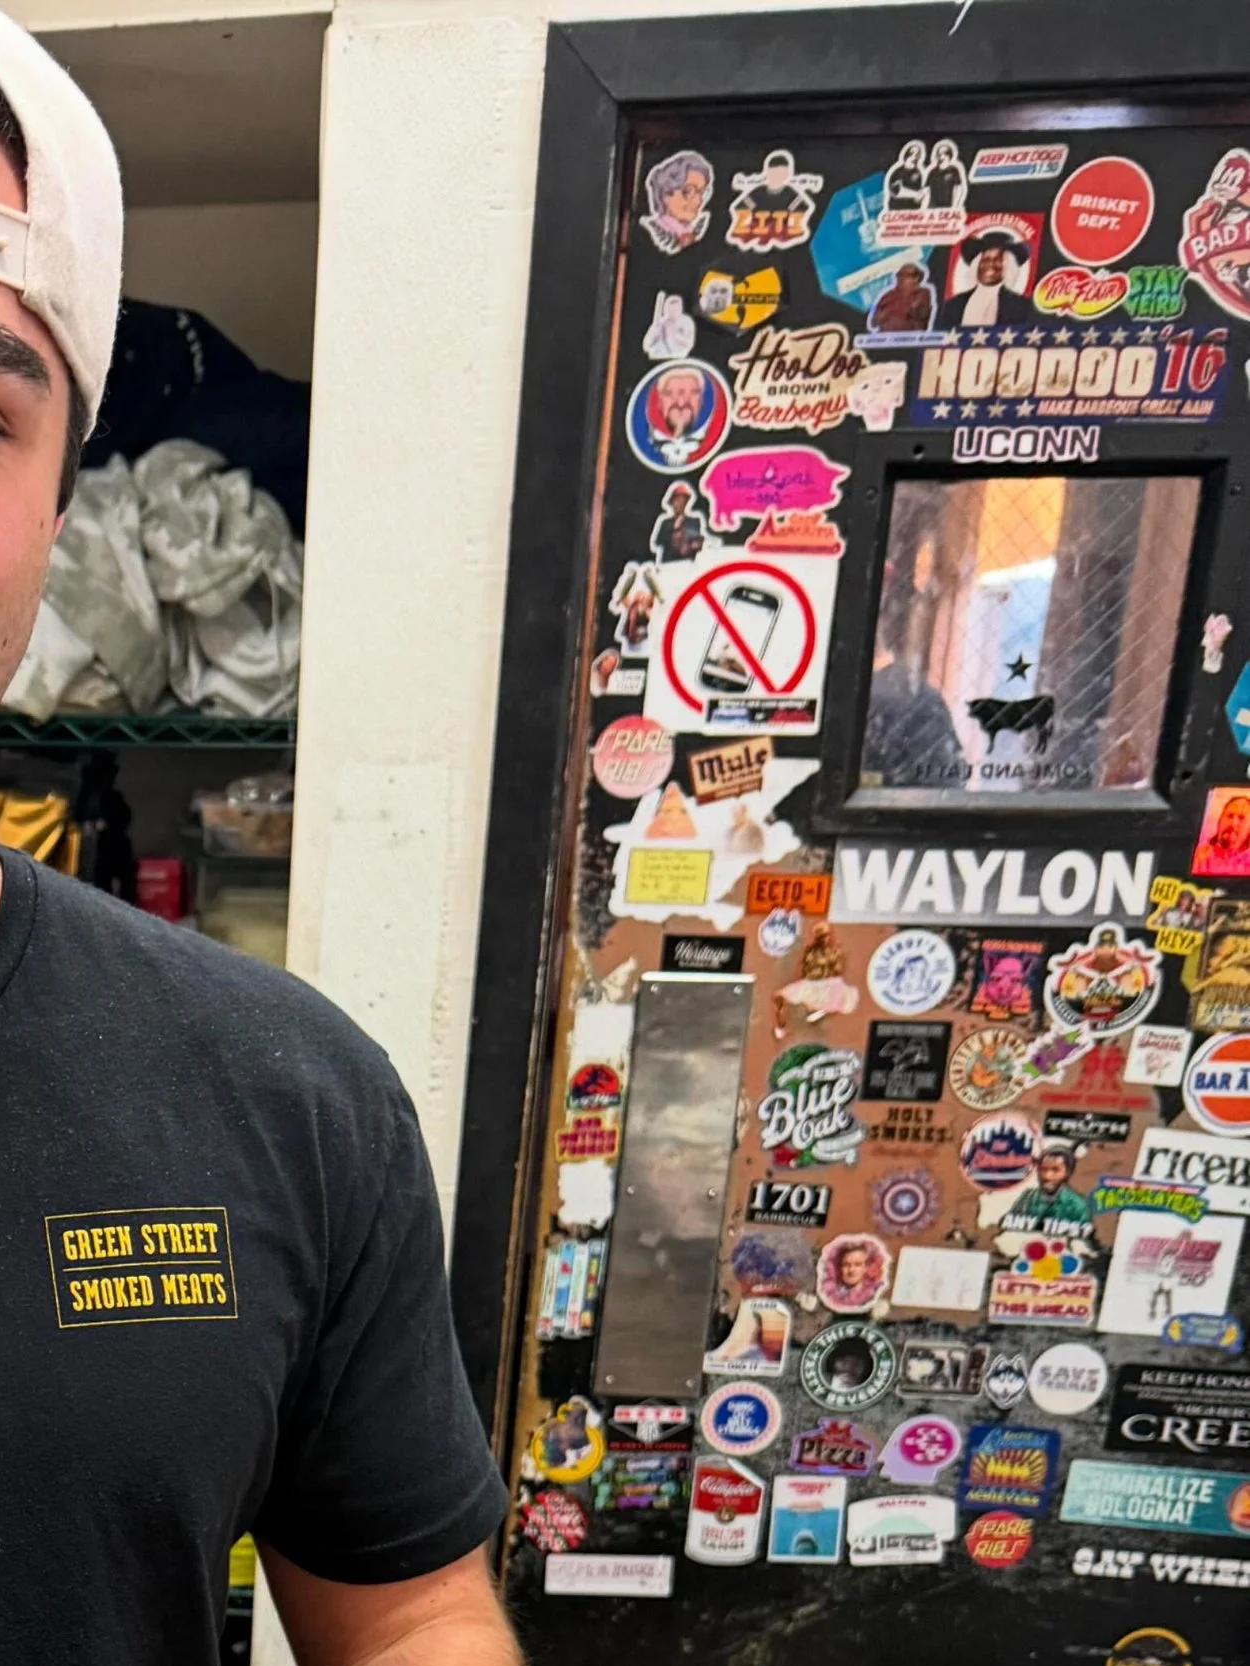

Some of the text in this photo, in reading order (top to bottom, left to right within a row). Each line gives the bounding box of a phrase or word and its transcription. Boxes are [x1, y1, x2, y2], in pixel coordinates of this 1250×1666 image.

[1069, 193, 1140, 214] BRISKET
[1077, 213, 1120, 230] DEPT.
[1191, 226, 1241, 259] BAD
[1130, 266, 1188, 292] STAY
[918, 347, 1158, 399] HOODOO
[767, 381, 831, 396] BROWN
[953, 426, 1101, 463] UCONN
[755, 879, 823, 902] ECTO-1
[840, 849, 1154, 917] WAYLON
[1195, 1071, 1231, 1091] BAR
[757, 1076, 855, 1150] Blue
[888, 1107, 935, 1123] HOLY
[791, 1102, 852, 1151] Oak
[870, 1125, 948, 1143] SMOKES
[750, 1181, 831, 1215] 1701
[1001, 1212, 1037, 1232] ANY
[62, 1223, 218, 1261] GREEN STREET
[69, 1273, 227, 1312] SMOKED MEATS
[992, 1301, 1030, 1316] THIS
[1141, 1369, 1194, 1386] KEEP
[964, 1518, 1035, 1539] SPARE
[973, 1539, 1027, 1560] RIBS
[1071, 1546, 1147, 1580] SAY
